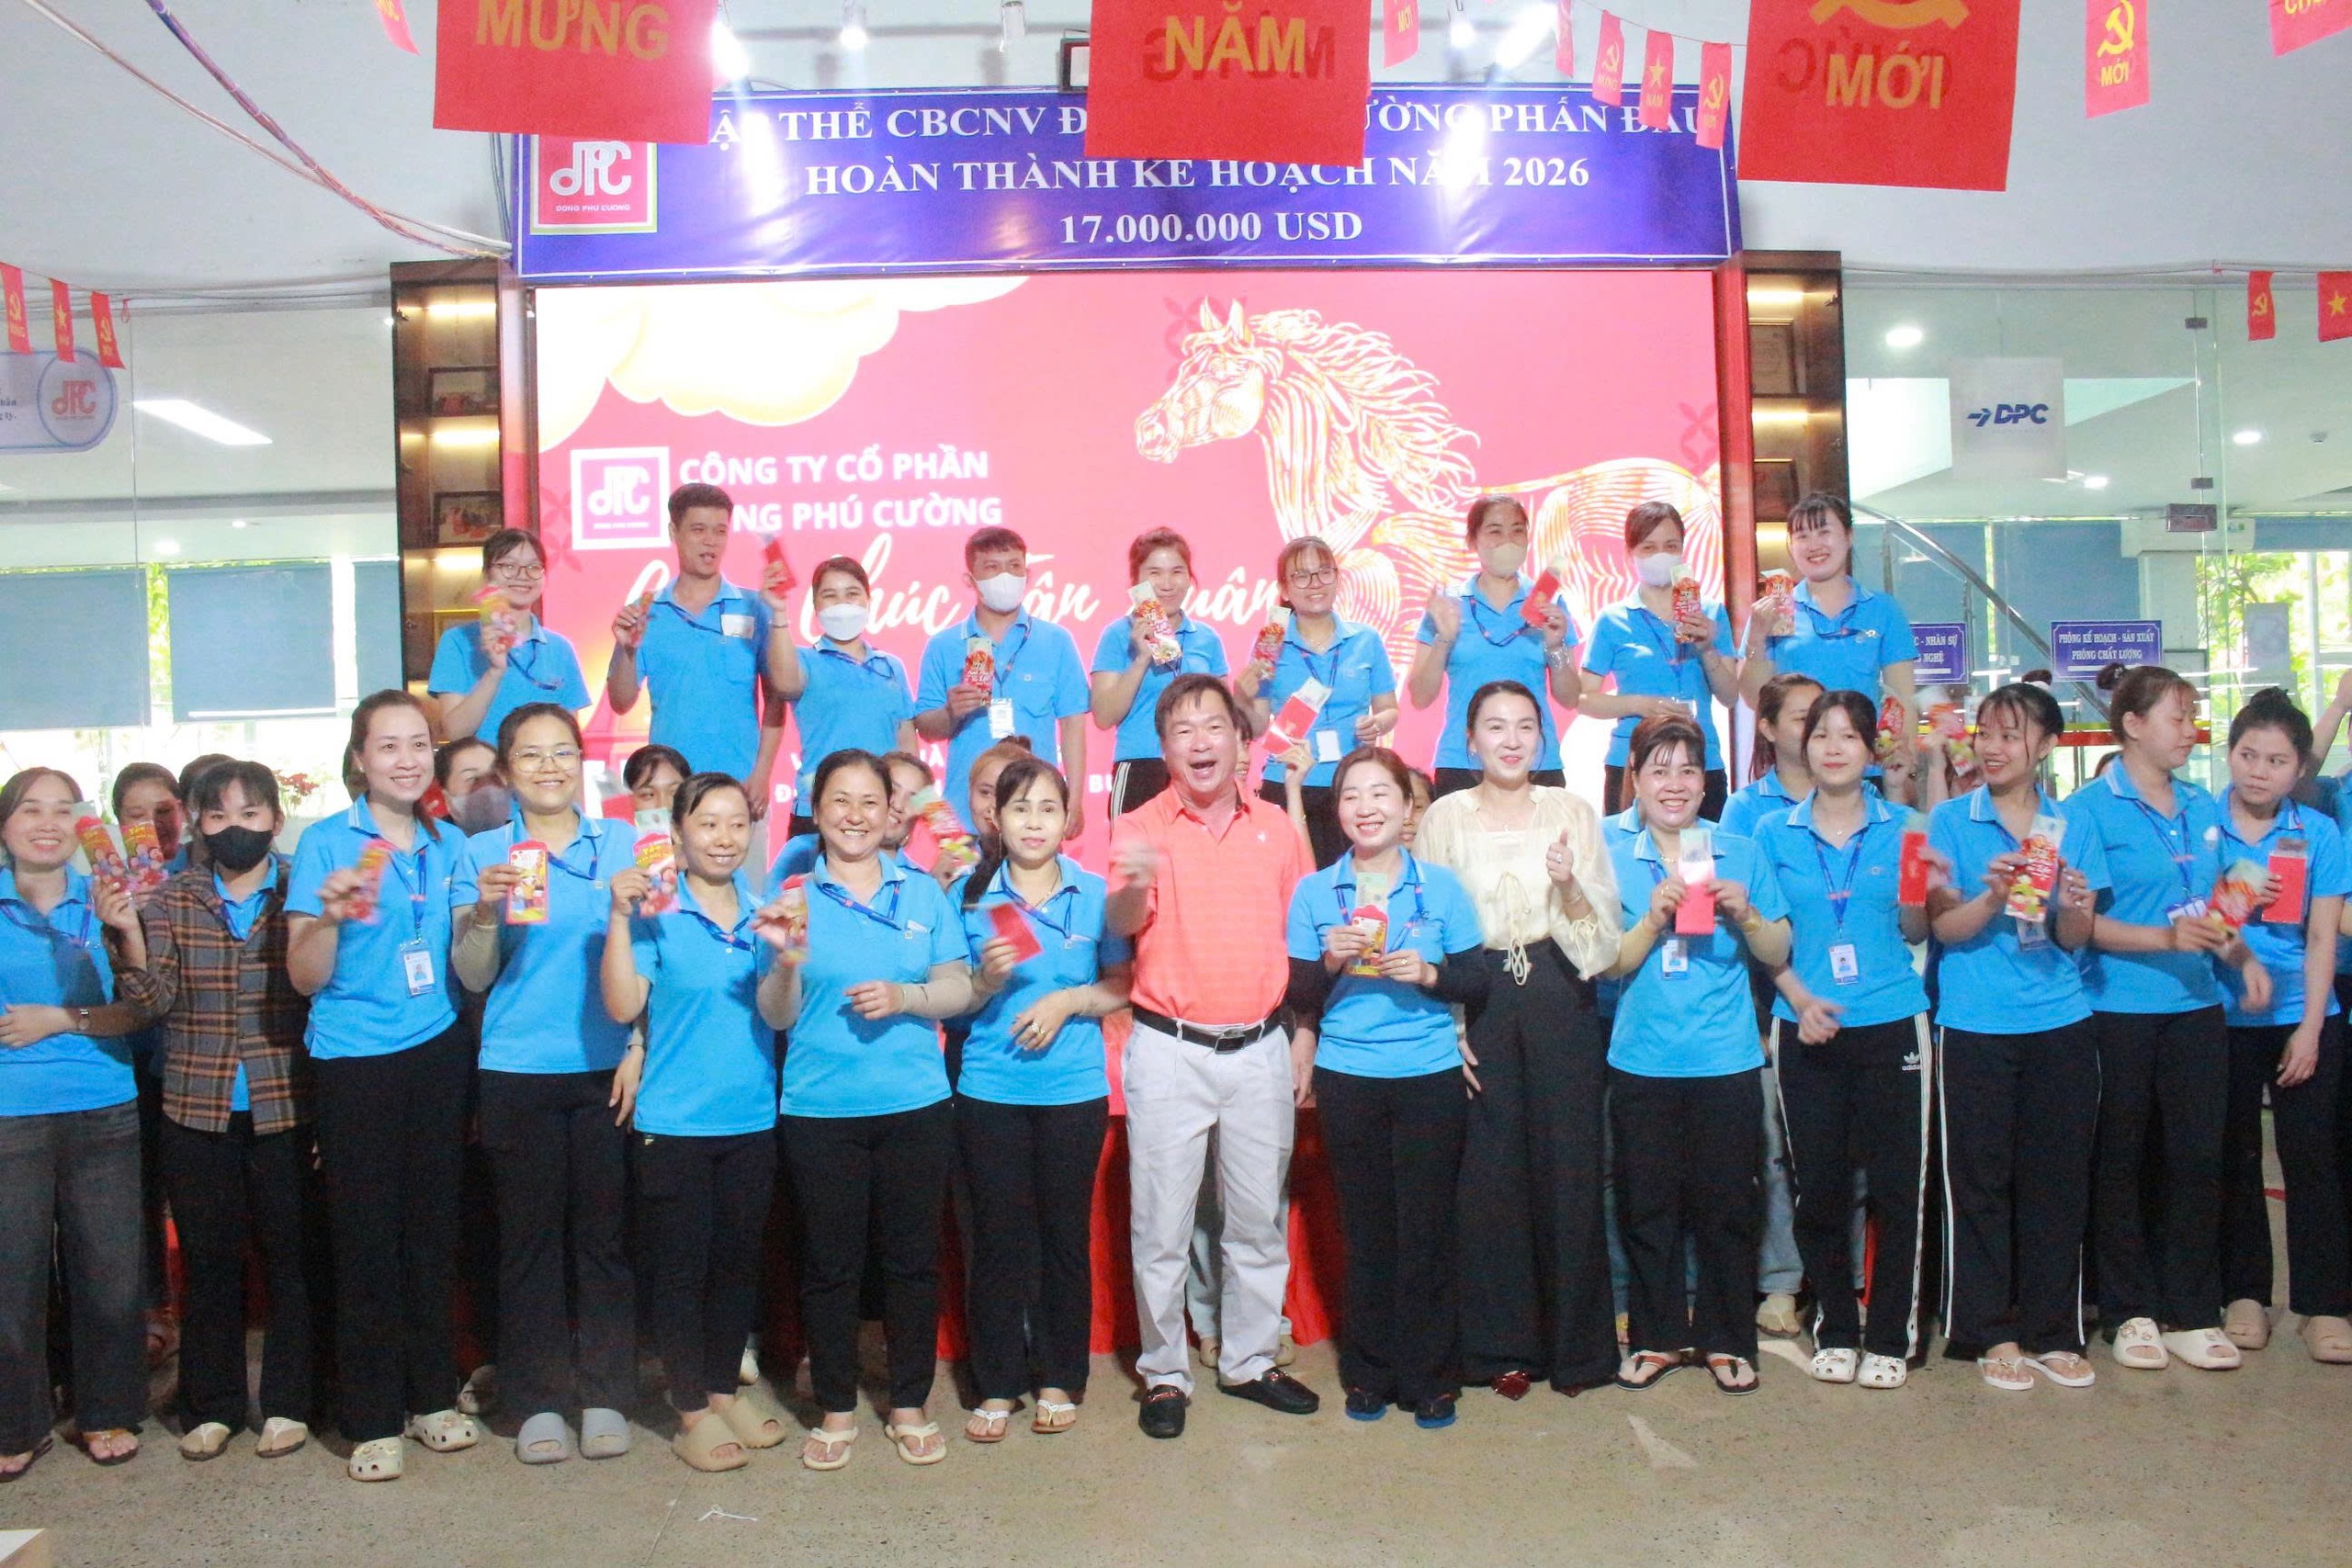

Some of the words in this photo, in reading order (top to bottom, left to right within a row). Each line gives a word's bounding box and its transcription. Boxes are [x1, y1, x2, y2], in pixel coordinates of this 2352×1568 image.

[1826, 40, 1945, 109] MỚI
[2100, 58, 2129, 86] MỚI
[887, 107, 1044, 138] CBCNV
[1489, 96, 1609, 133] PHẤN
[806, 155, 940, 195] HOÀN
[953, 153, 1119, 190] THÀNH
[1208, 160, 1376, 193] HOẠCH
[1503, 156, 1590, 186] 2026
[1061, 213, 1261, 243] 17.000.000
[1275, 211, 1363, 241] USD
[1993, 403, 2049, 424] DPC
[680, 451, 777, 486] CÔNG
[786, 456, 828, 482] TY
[836, 443, 883, 481] CỔ
[892, 443, 989, 479] PHẦN
[792, 493, 865, 530] PHÚ
[873, 491, 1002, 527] CƯỜNG
